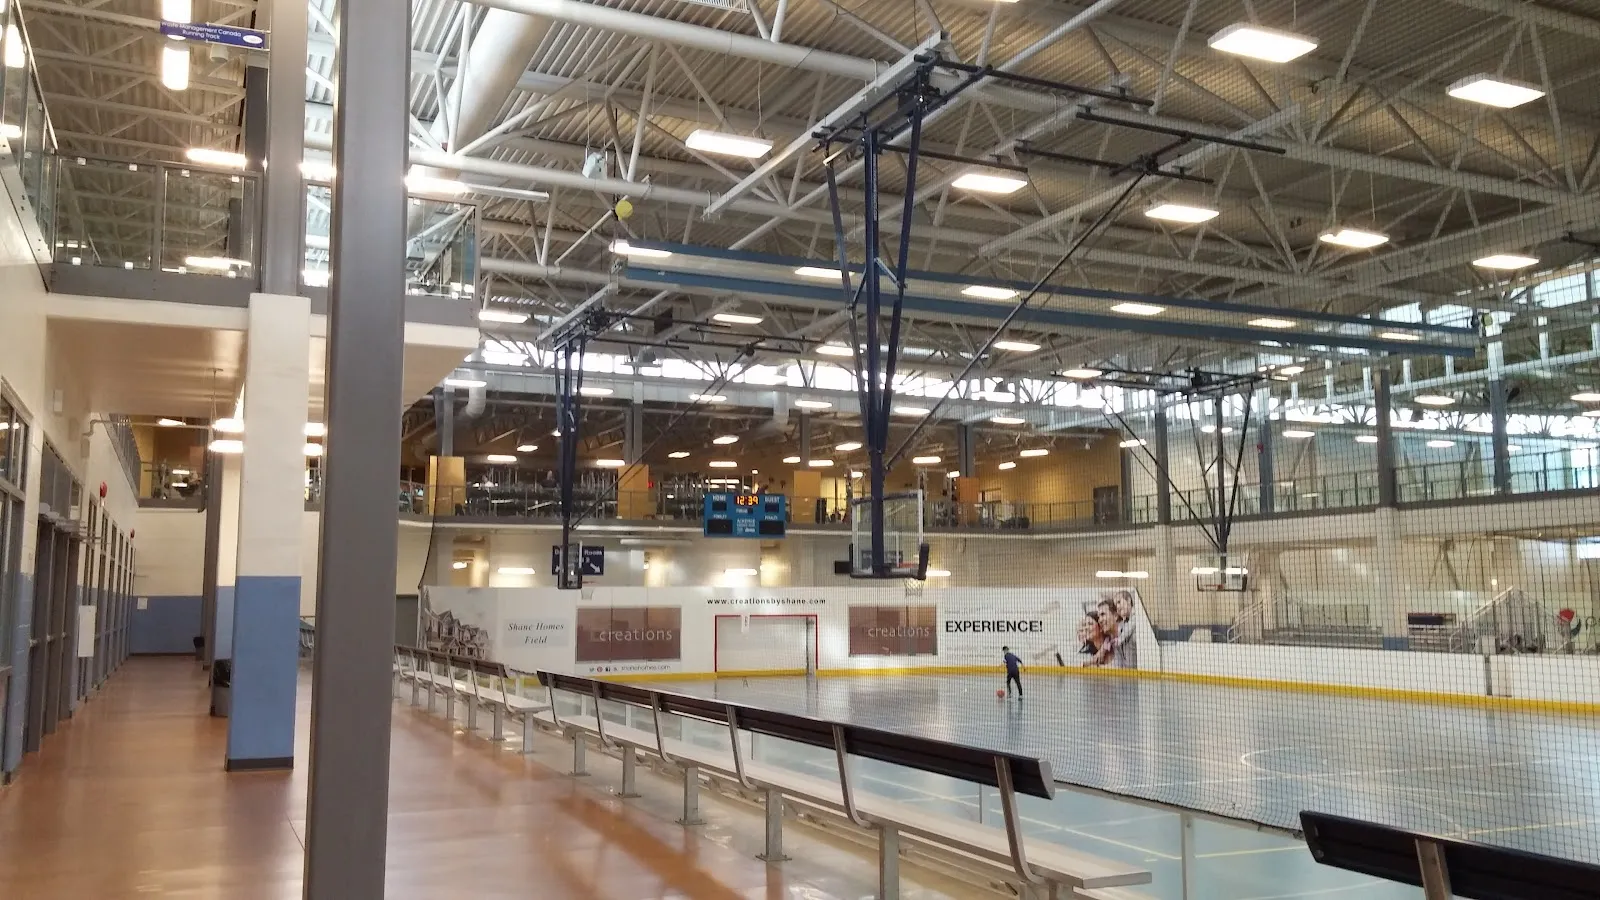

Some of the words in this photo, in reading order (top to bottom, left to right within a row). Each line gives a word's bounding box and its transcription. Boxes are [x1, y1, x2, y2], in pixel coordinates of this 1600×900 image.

[179, 24, 218, 34] Management
[218, 29, 242, 37] Canada
[182, 30, 205, 38] Running
[706, 597, 826, 606] www.creationsbyshane.com
[508, 623, 532, 631] Shane
[536, 622, 564, 630] Homes
[867, 625, 930, 637] creations
[945, 620, 1043, 632] EXPERIENCE!
[524, 635, 548, 644] Field
[599, 628, 673, 642] creations
